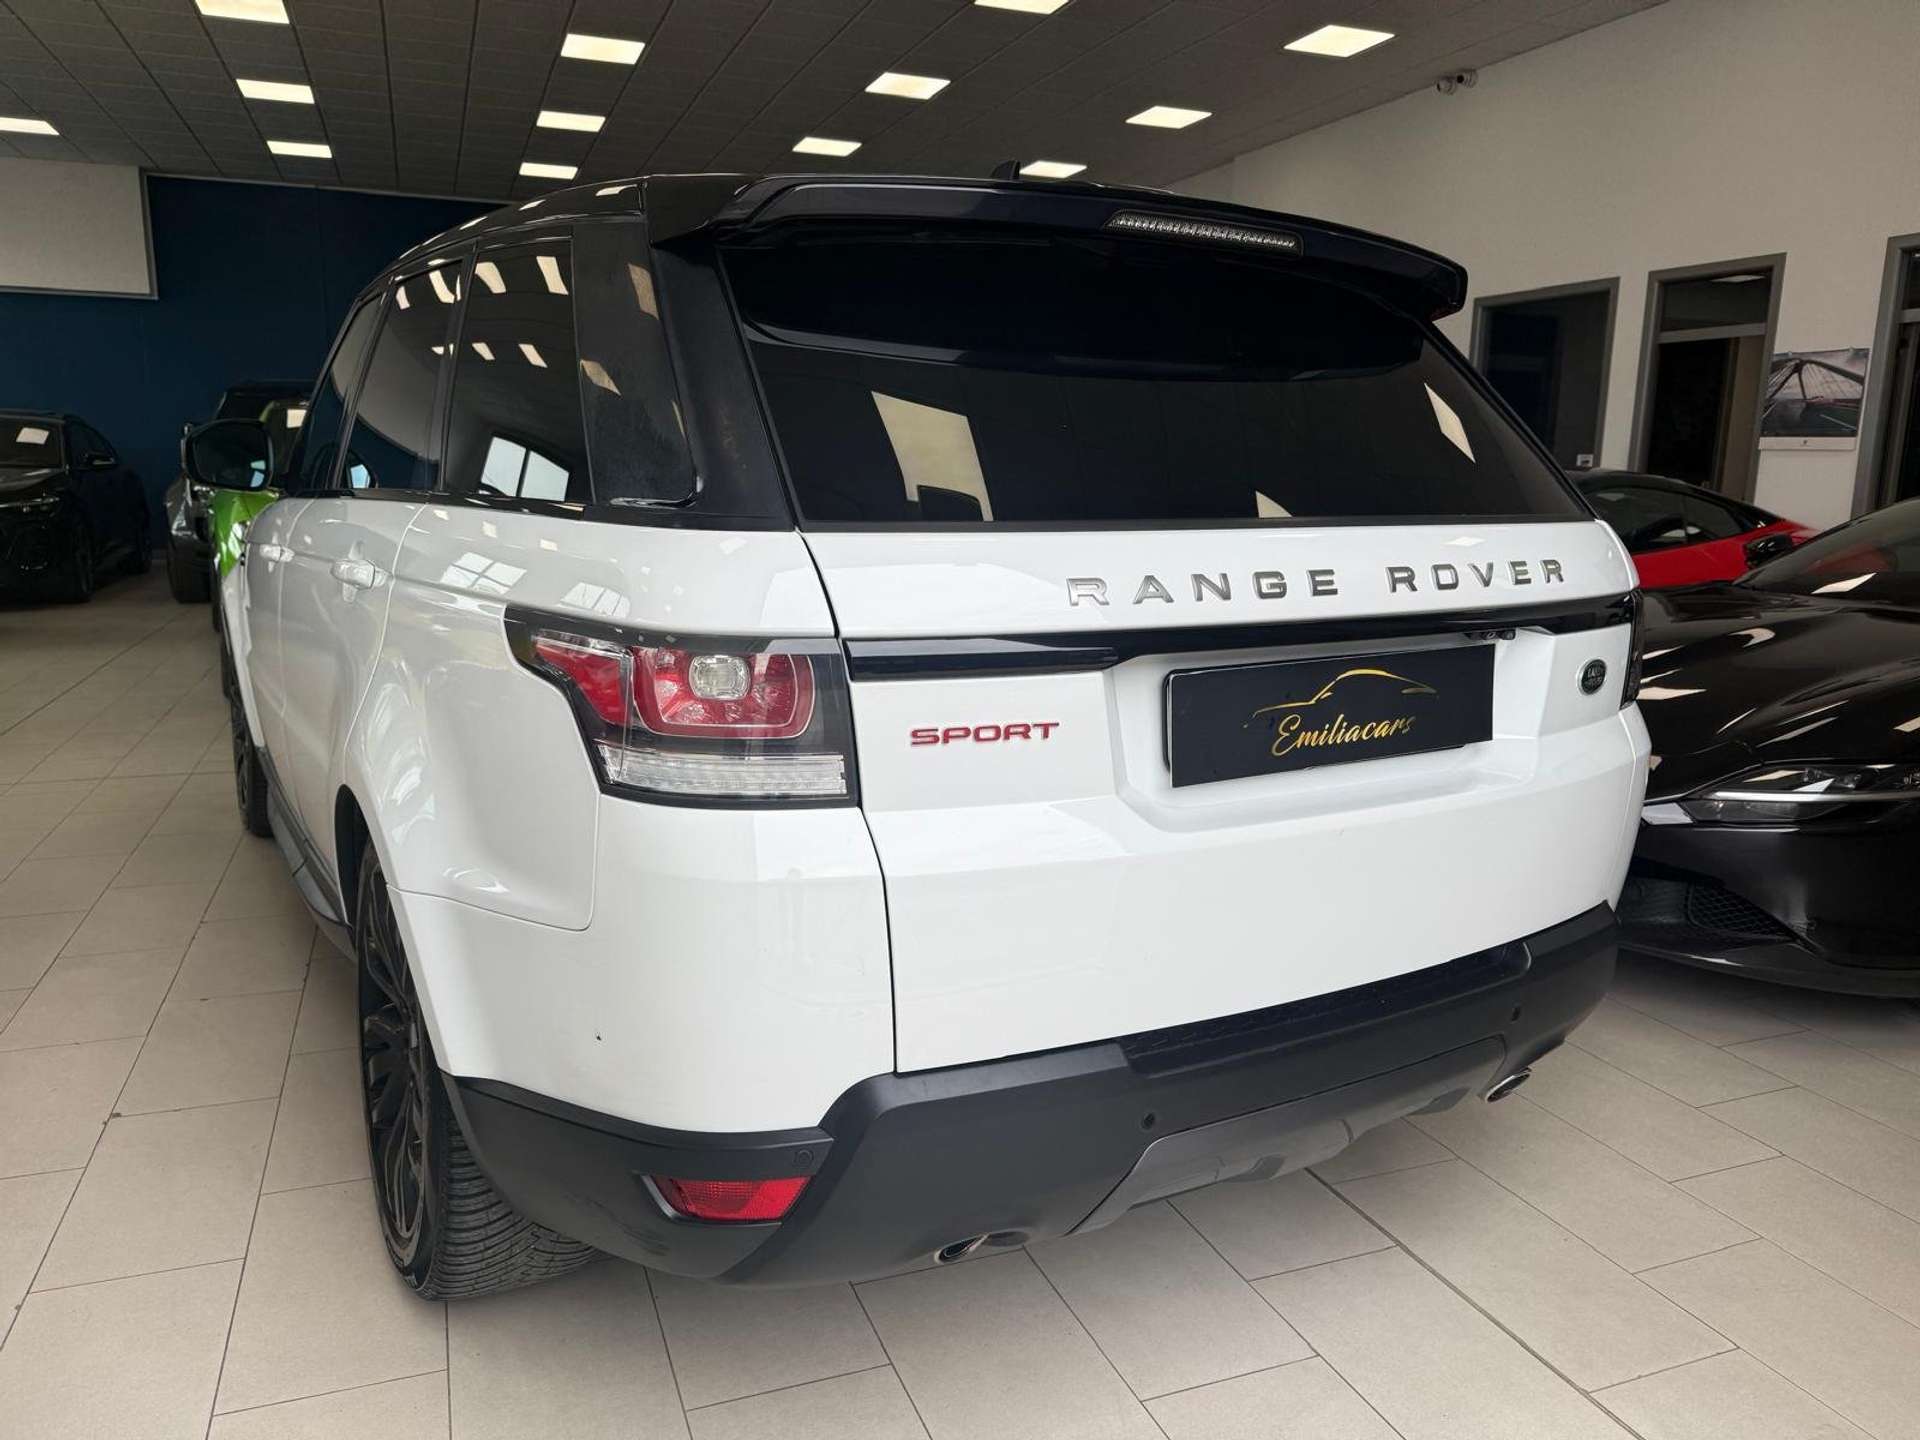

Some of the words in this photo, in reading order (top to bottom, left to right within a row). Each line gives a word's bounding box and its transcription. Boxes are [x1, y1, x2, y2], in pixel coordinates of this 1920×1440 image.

[1066, 568, 1339, 606] RANGE
[1385, 559, 1565, 593] ROVER
[910, 722, 1060, 746] SPORT
[1271, 713, 1416, 757] Emiliacars
